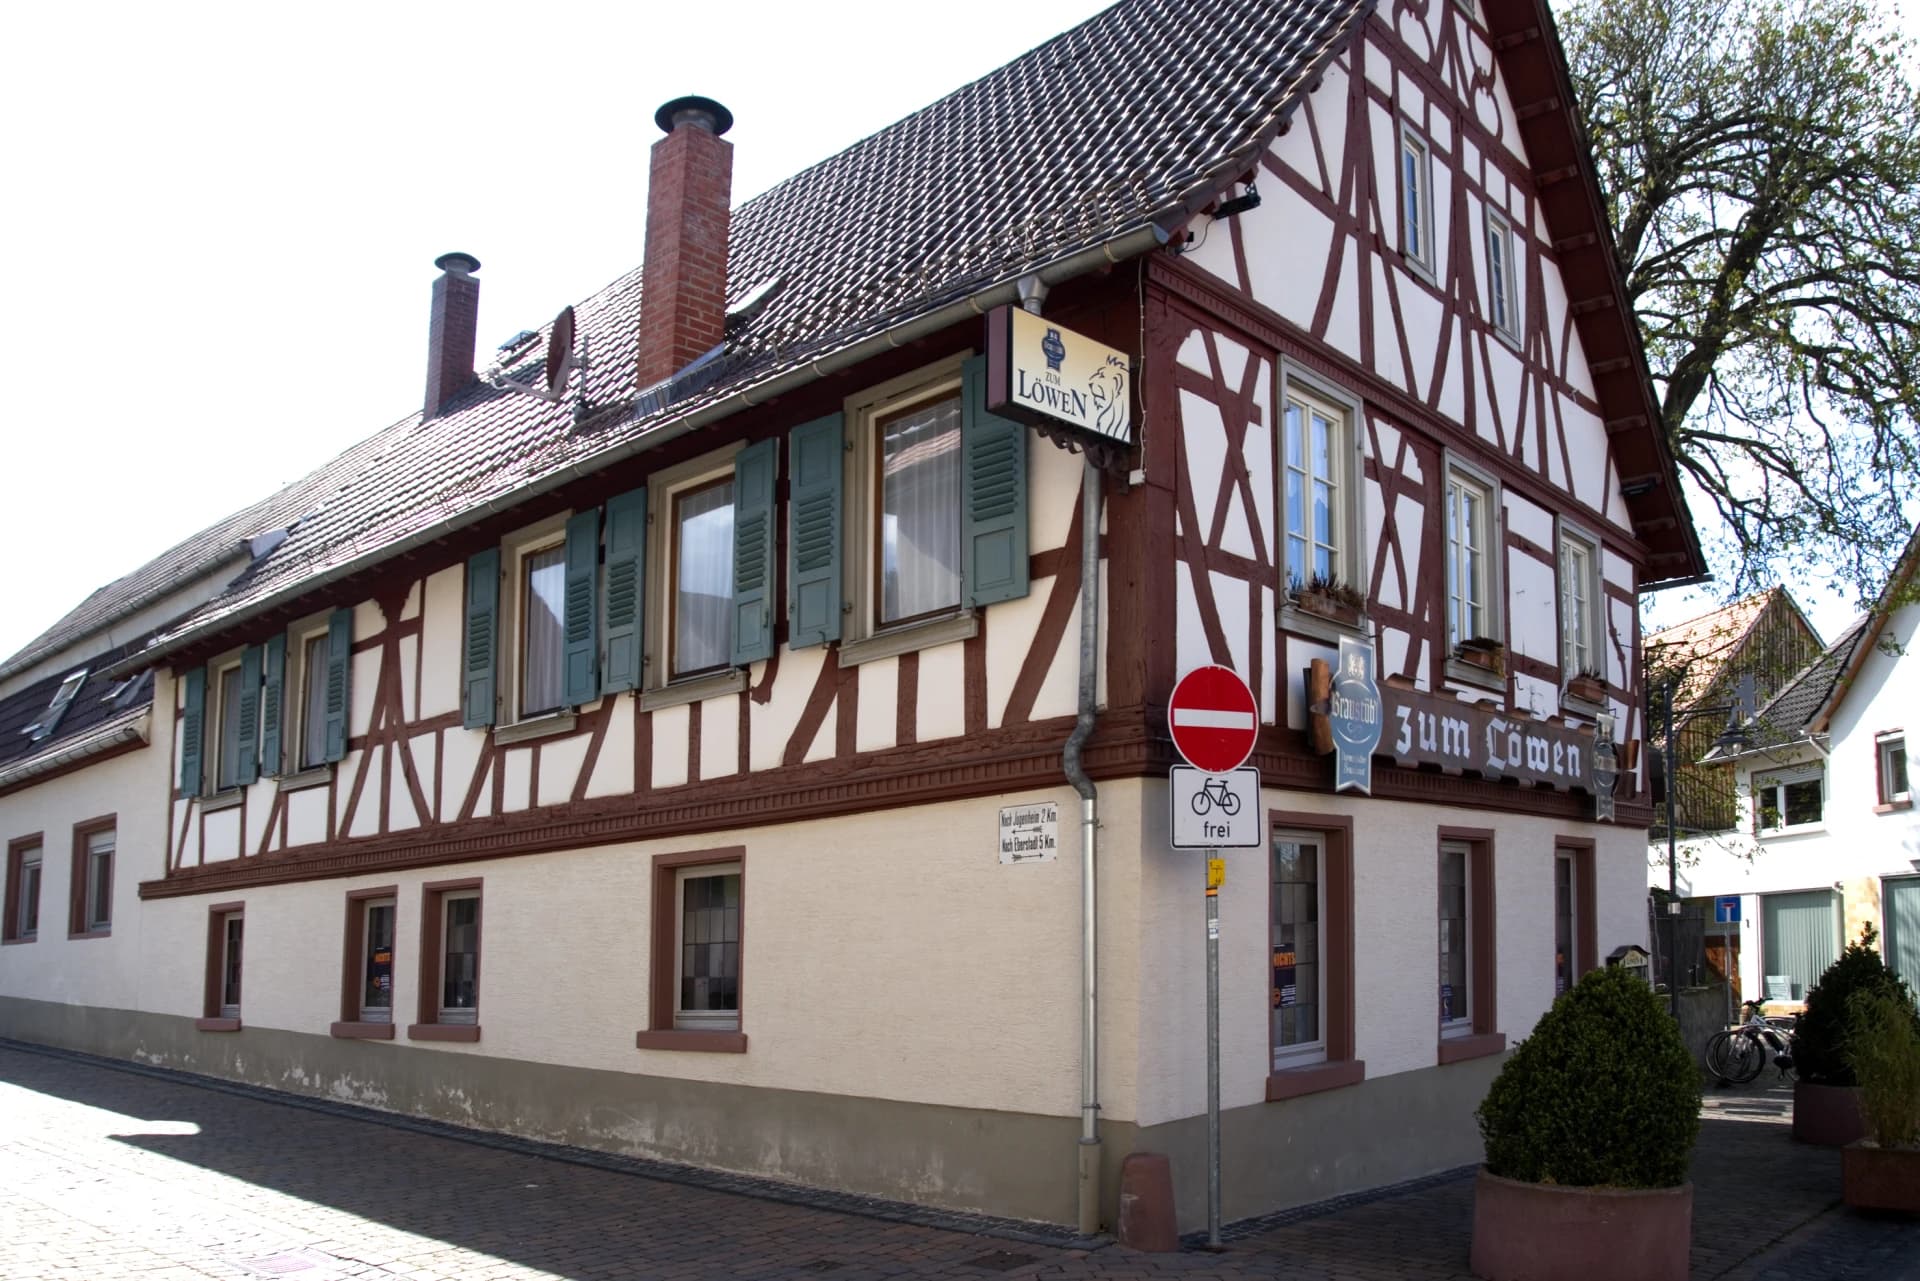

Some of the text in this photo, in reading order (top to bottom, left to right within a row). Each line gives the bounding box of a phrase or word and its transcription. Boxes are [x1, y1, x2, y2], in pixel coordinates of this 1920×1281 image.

[1045, 371, 1061, 386] ZUM
[1018, 368, 1088, 419] LÖWEN
[1396, 704, 1582, 779] Zum Löwen
[1041, 808, 1046, 823] 2
[1204, 820, 1231, 838] frei
[1039, 833, 1044, 850] 5
